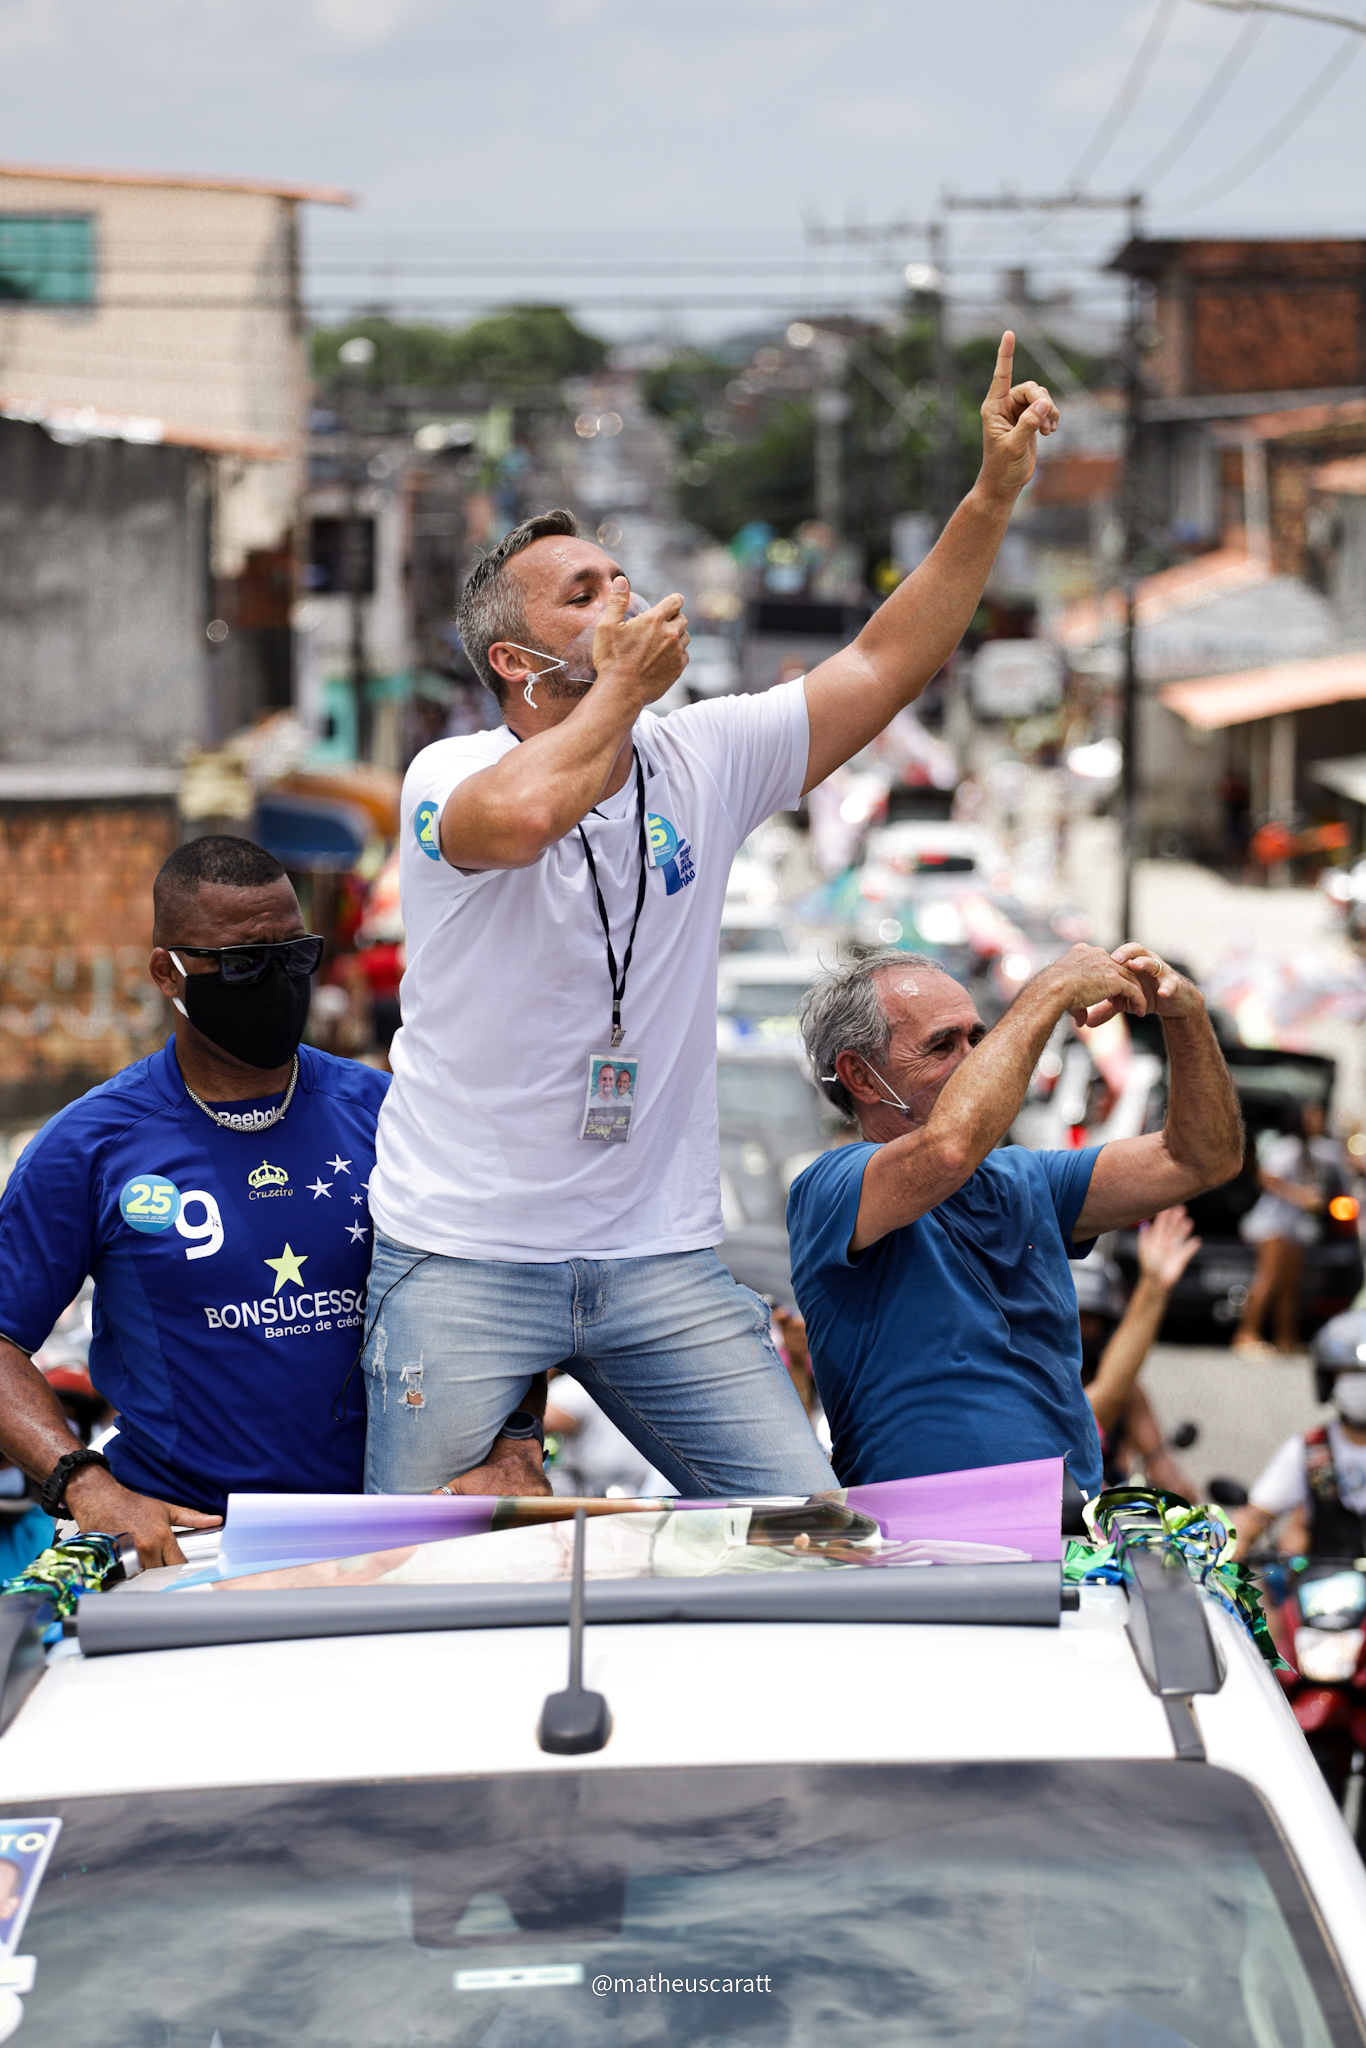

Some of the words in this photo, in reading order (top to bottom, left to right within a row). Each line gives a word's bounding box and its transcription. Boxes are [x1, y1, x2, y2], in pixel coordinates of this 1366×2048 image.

[126, 1183, 175, 1216] 25
[248, 1187, 294, 1201] Cruzeiro
[174, 1189, 225, 1261] 9
[265, 1323, 311, 1339] Banco
[315, 1319, 332, 1332] de
